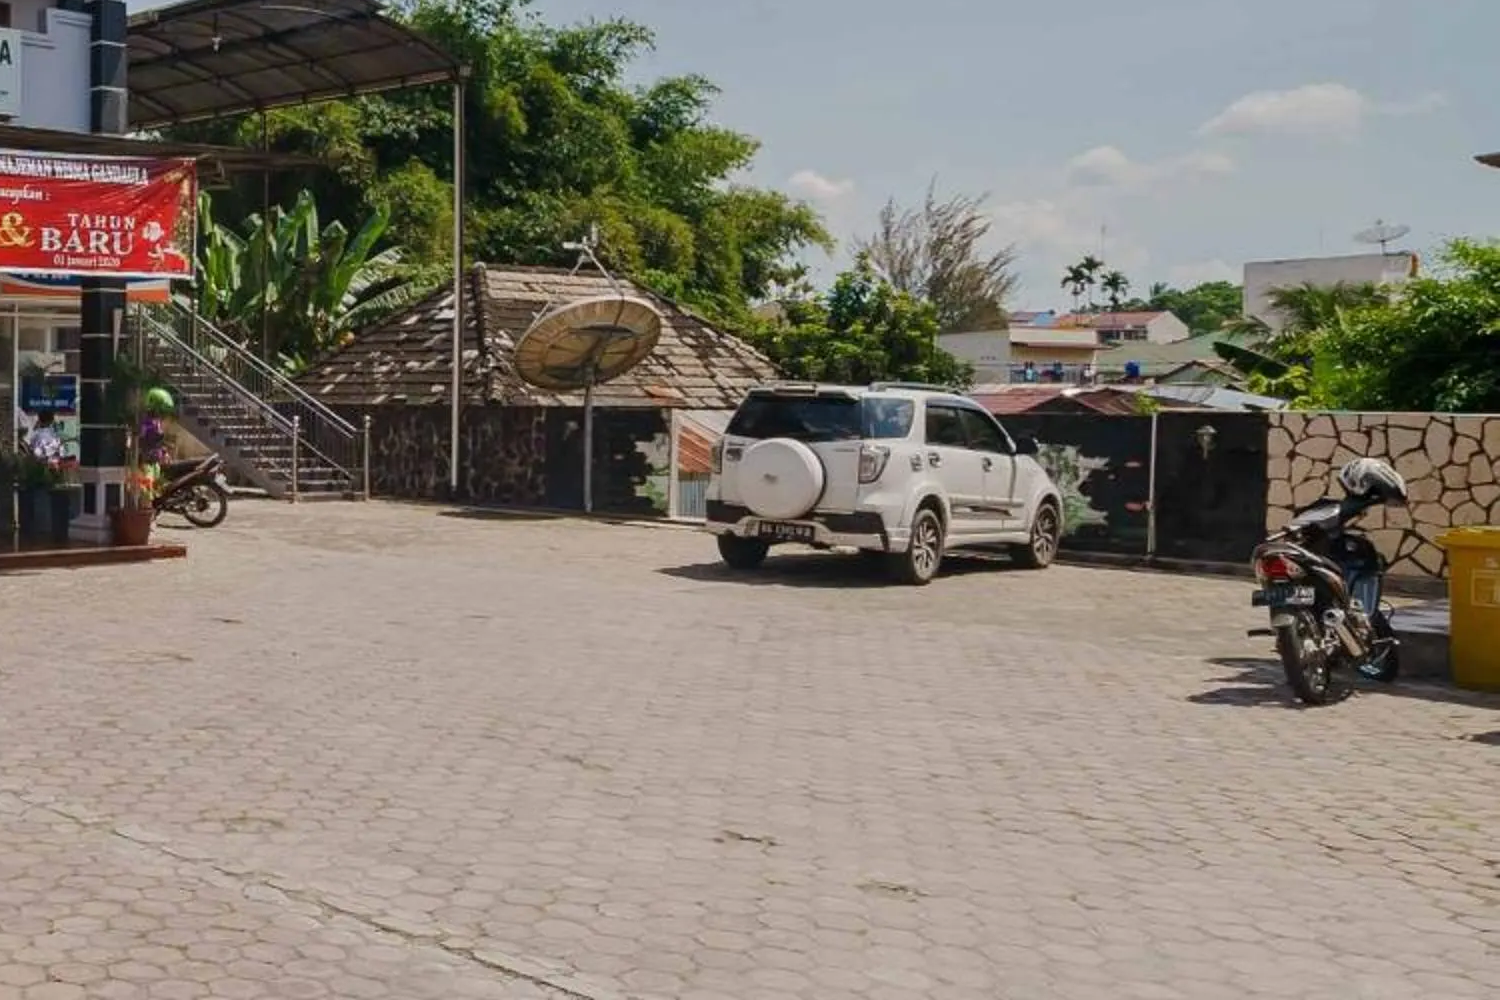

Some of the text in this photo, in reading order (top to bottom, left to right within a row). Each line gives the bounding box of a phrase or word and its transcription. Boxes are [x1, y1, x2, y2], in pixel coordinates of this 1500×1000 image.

[53, 158, 91, 181] WISMA
[91, 164, 149, 186] GANDAULA
[67, 213, 136, 230] TAHUN
[40, 226, 135, 256] BARU
